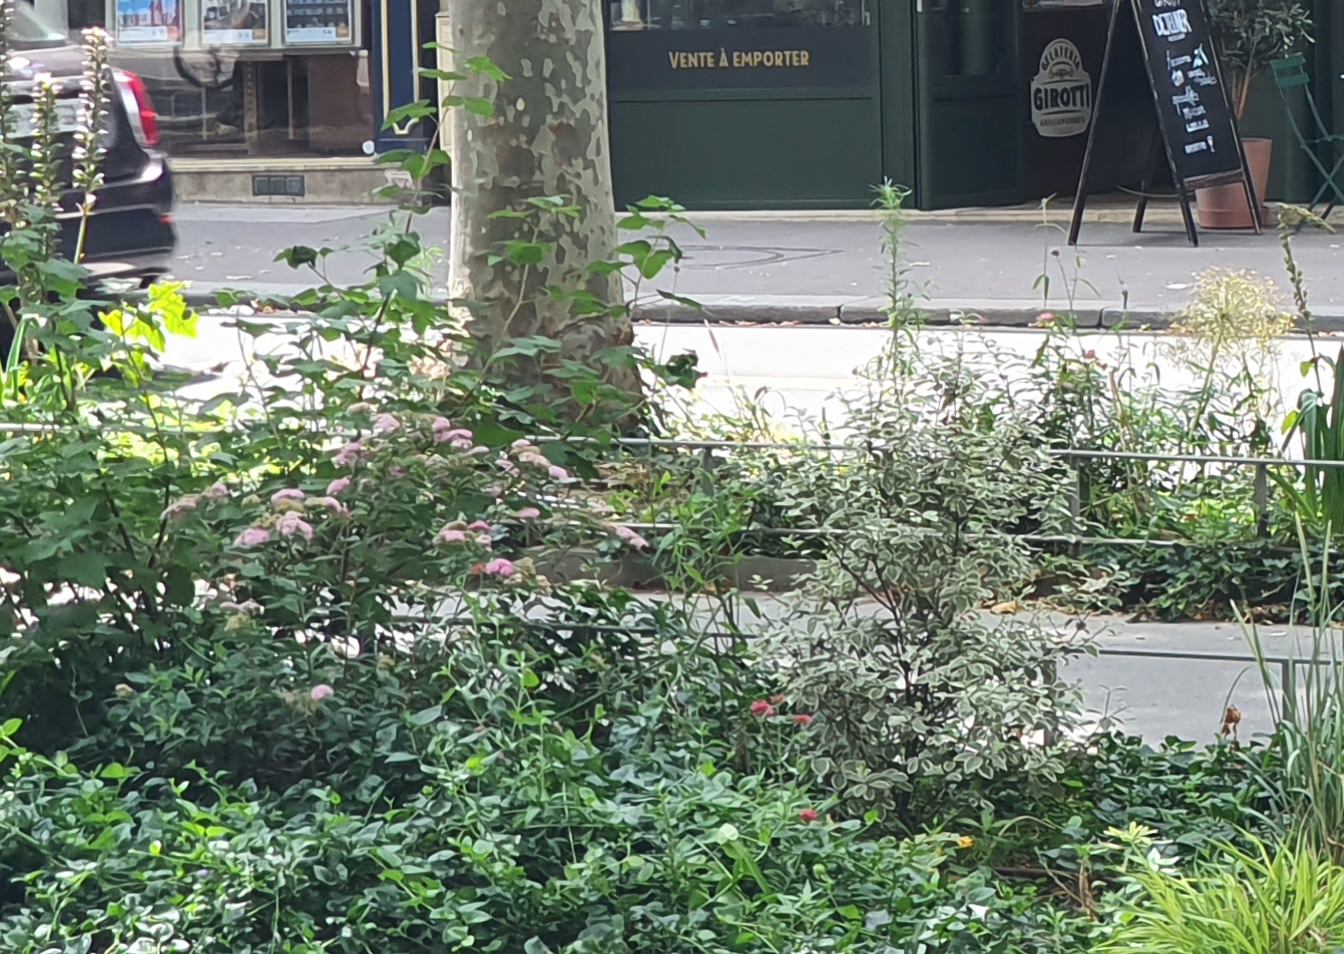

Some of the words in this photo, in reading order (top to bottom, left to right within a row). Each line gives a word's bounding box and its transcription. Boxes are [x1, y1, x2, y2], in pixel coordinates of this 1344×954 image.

[669, 51, 715, 69] VENTE
[719, 47, 729, 67] À
[733, 50, 810, 67] EMPORTER
[1033, 83, 1090, 112] GIROTTI
